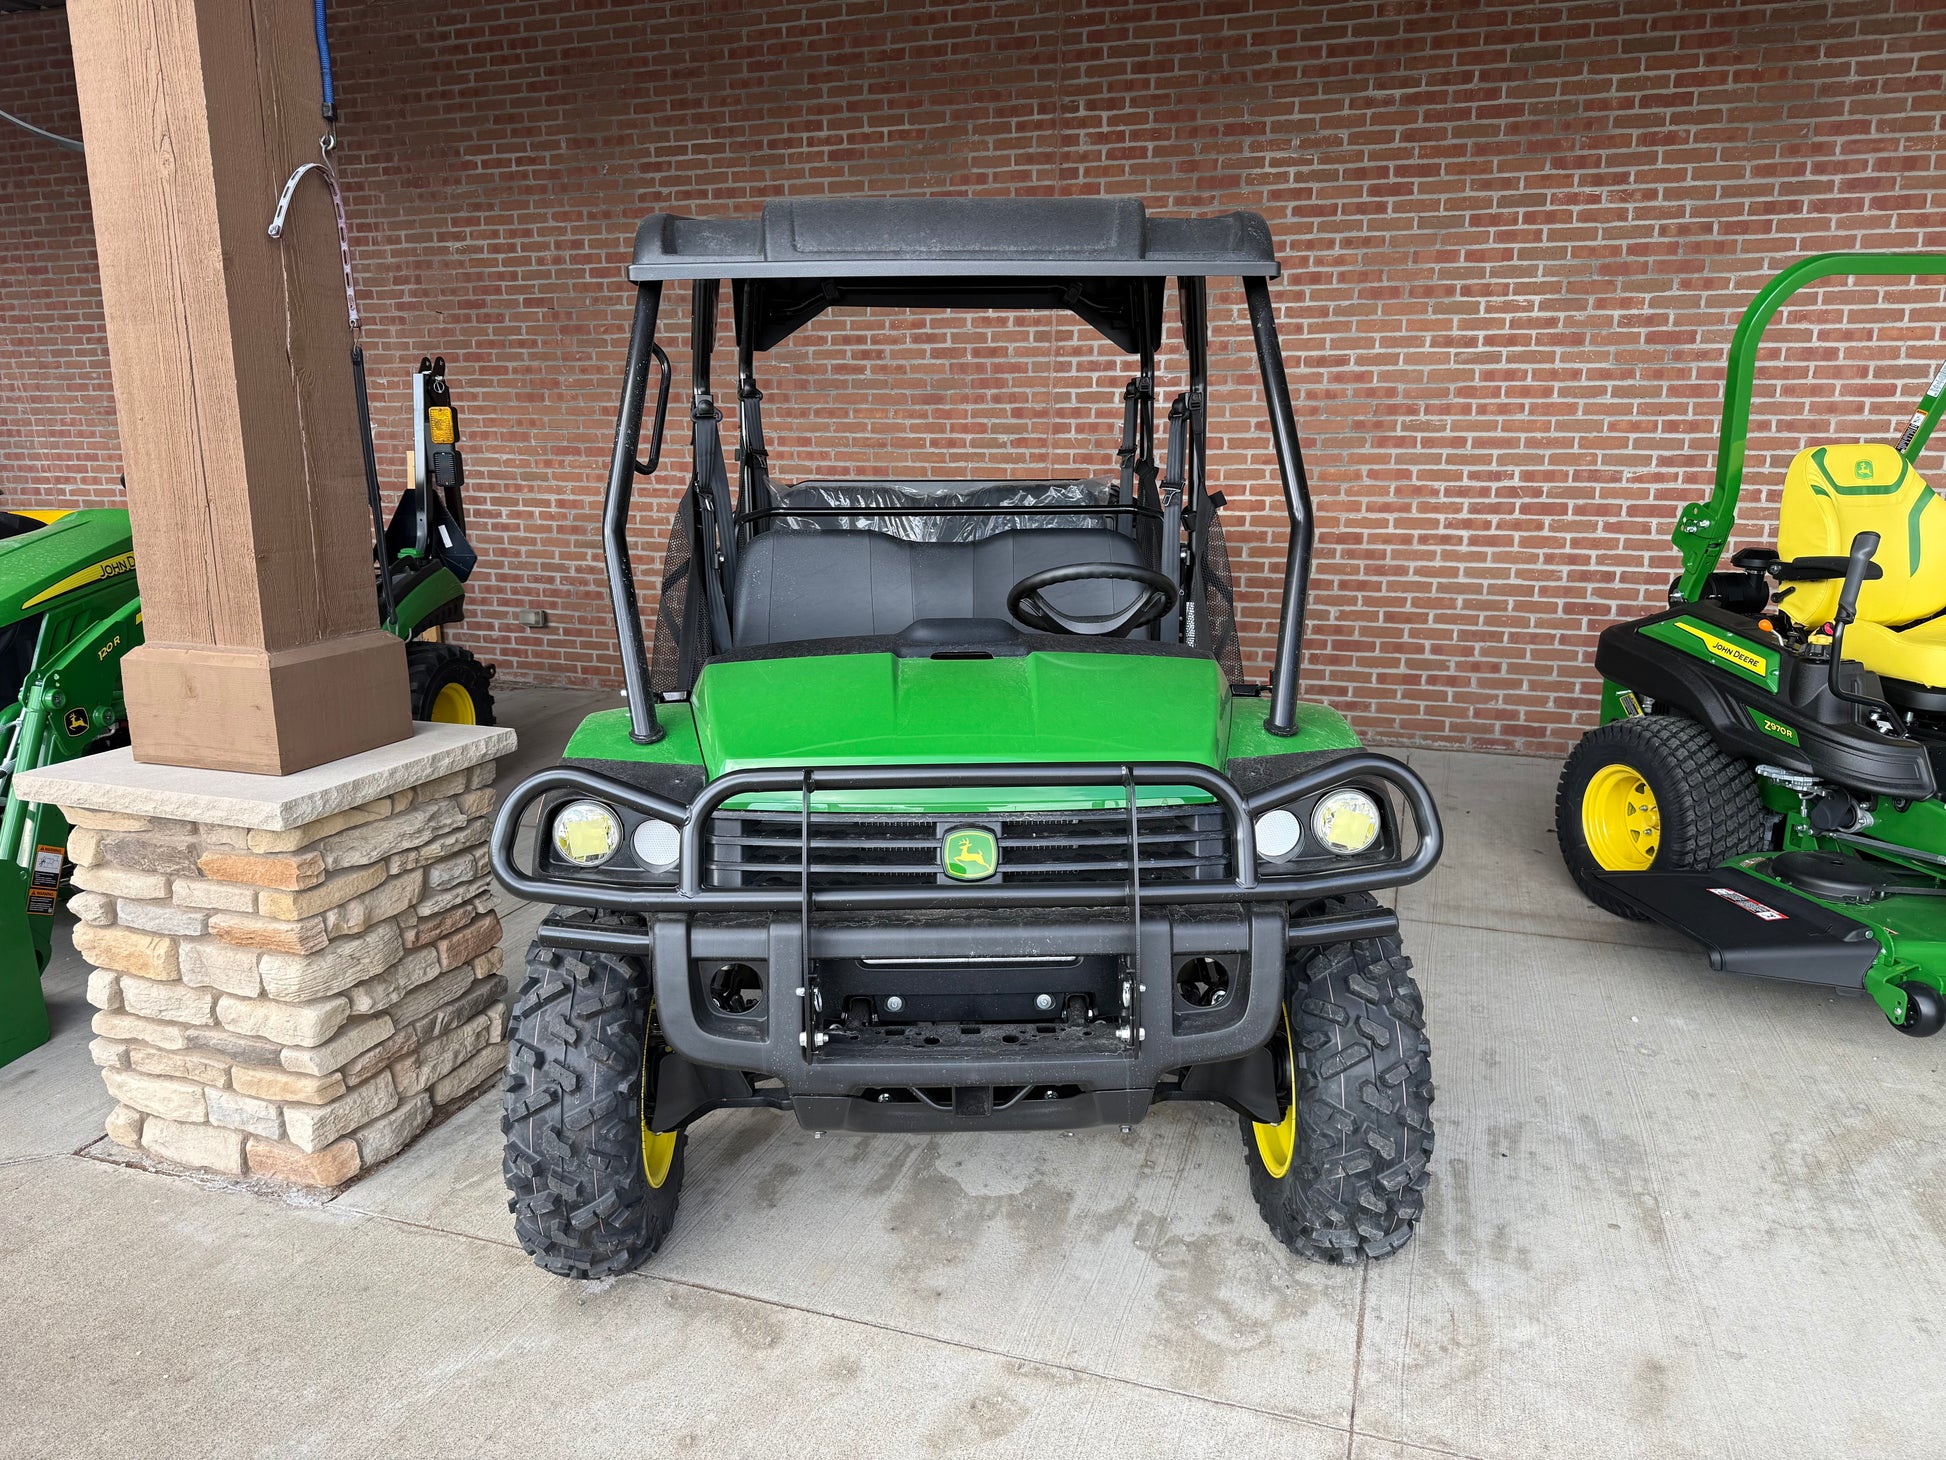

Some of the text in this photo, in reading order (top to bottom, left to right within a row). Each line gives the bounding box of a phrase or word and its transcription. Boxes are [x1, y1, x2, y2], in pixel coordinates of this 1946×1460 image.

[100, 560, 127, 577] JOHN
[98, 642, 114, 661] 120
[1712, 642, 1760, 667] JOHN DEERE
[1764, 719, 1793, 738] Z970R
